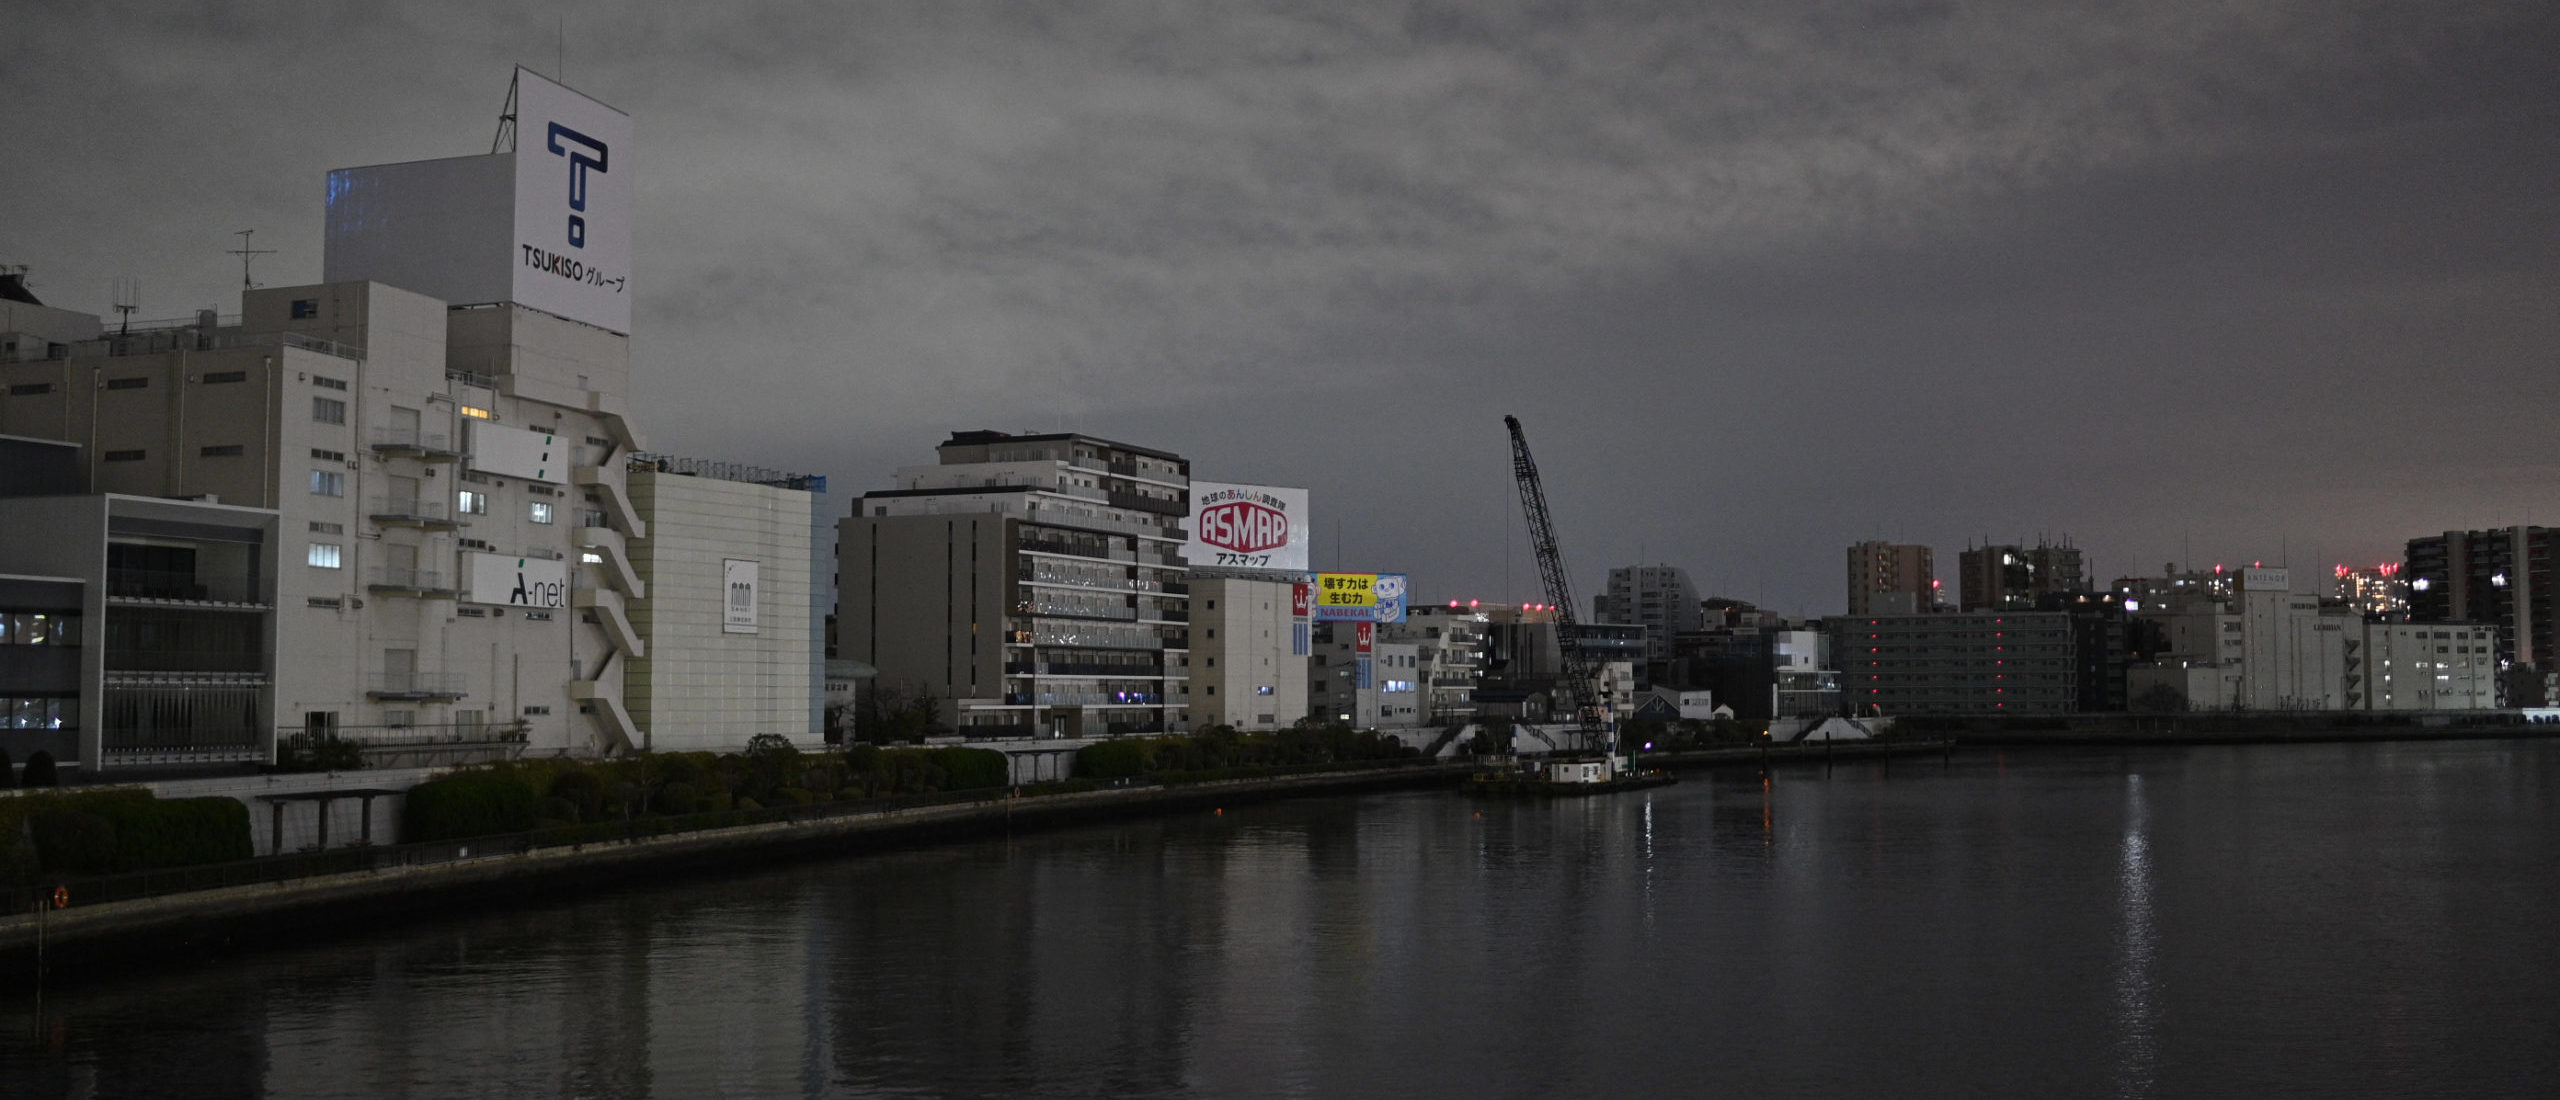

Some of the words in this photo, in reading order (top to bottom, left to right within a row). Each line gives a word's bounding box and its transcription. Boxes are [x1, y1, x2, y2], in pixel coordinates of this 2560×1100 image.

[522, 244, 583, 281] TSUKISO
[586, 267, 625, 293] グループ
[1201, 488, 1287, 511] 地球のあんしん調査隊
[1202, 505, 1286, 550] ASMAP
[1216, 552, 1271, 566] アスマップ
[510, 559, 565, 608] A-net
[1324, 577, 1369, 590] 壊す力は
[1330, 592, 1363, 604] 生む力
